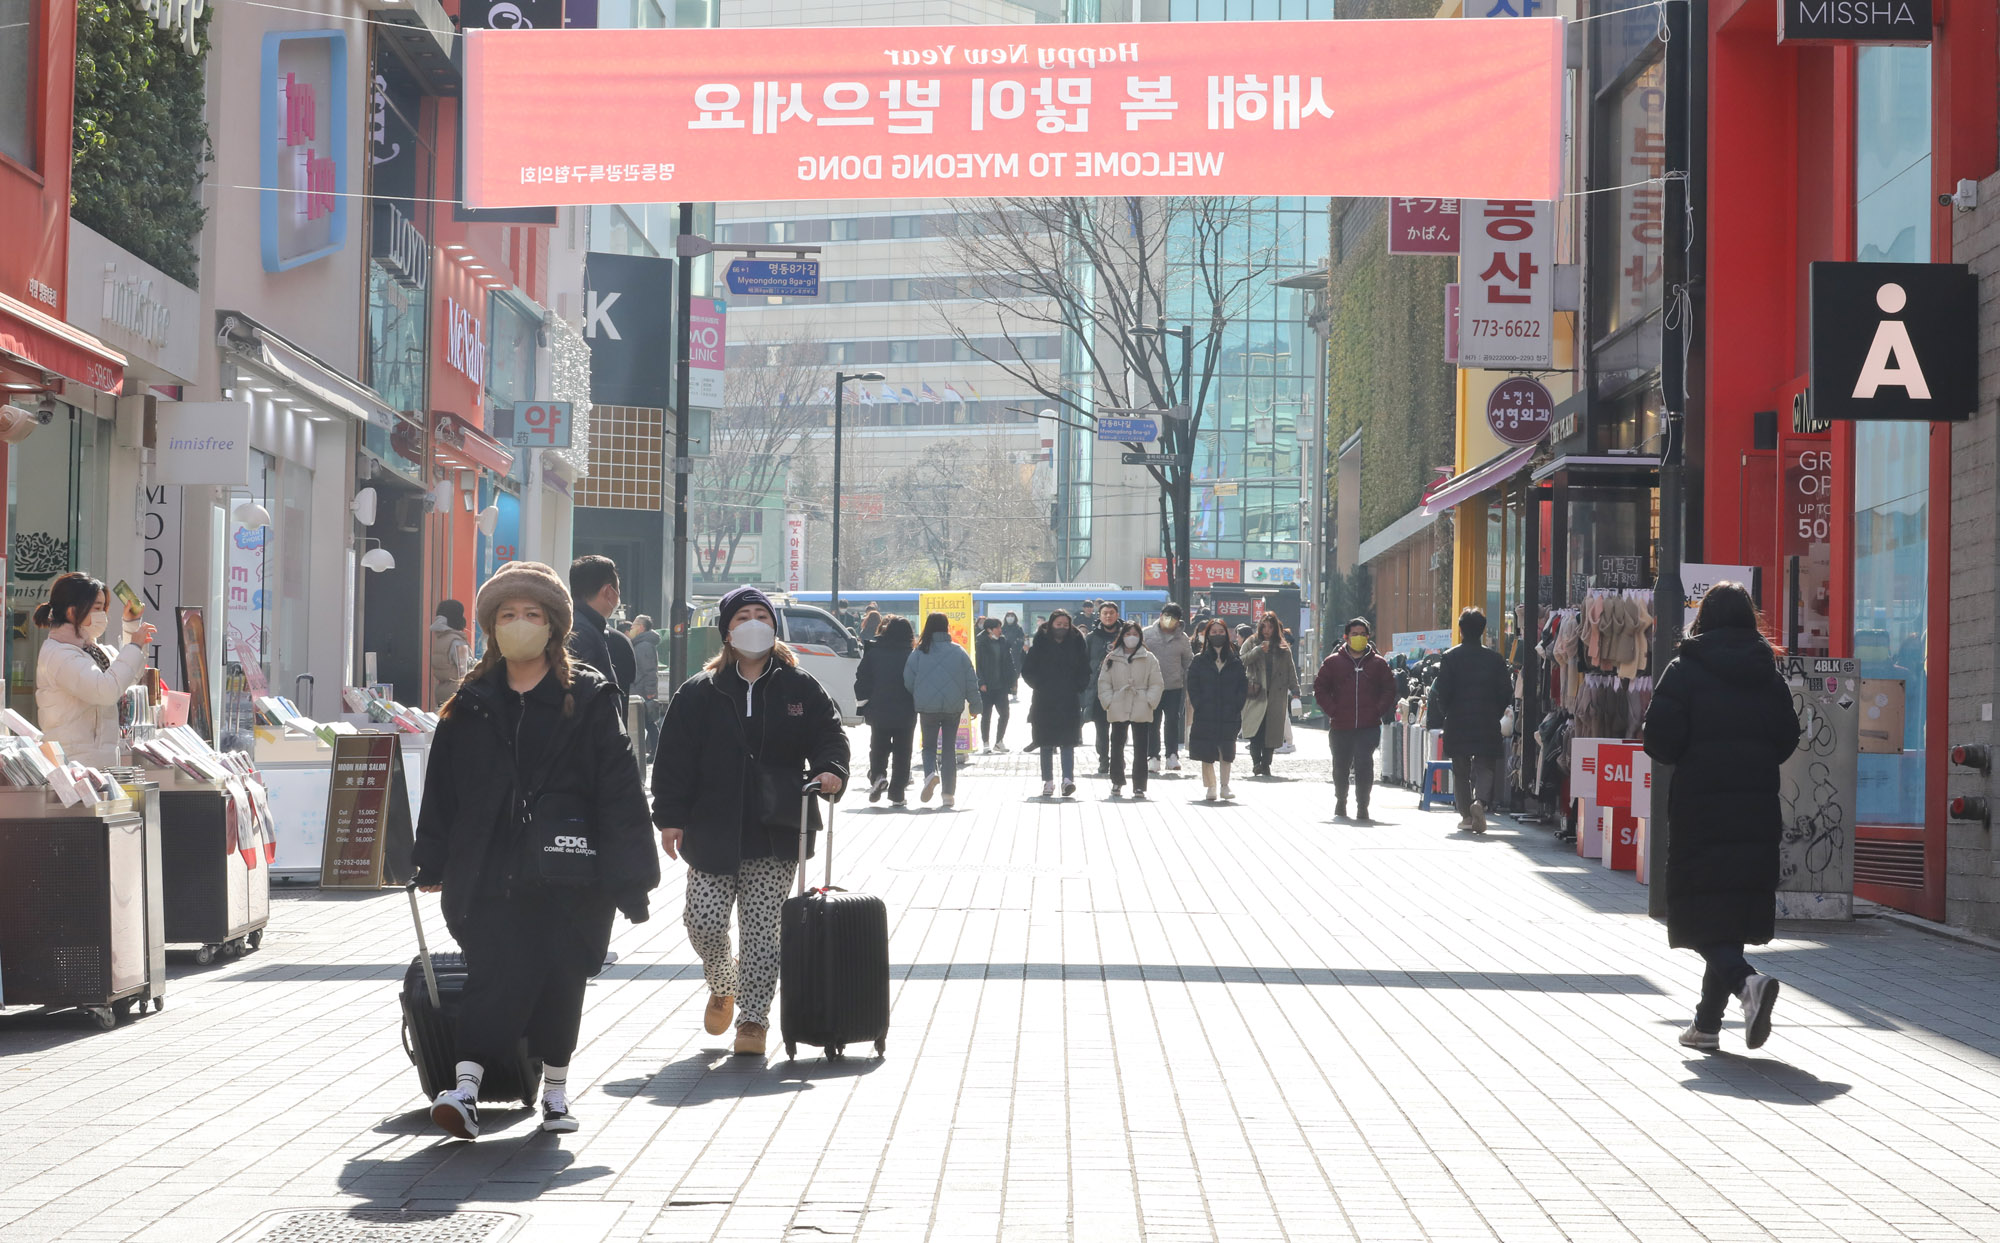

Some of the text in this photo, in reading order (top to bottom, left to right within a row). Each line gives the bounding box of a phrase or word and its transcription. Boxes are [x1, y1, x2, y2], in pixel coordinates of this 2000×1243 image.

[1800, 1, 1915, 24] MISSHA
[1407, 226, 1450, 241] かばん
[390, 203, 427, 289] LLOYD
[768, 263, 816, 276] 명동8가길
[737, 276, 816, 286] Myeongdong 8ga-gil
[102, 262, 170, 348] innisfree
[1472, 320, 1540, 337] 773-6622
[447, 296, 485, 406] McNally
[1502, 391, 1534, 406] 노정식
[525, 405, 562, 444] 약
[1491, 408, 1550, 429] 성형외과
[169, 436, 234, 450] innisfree
[1798, 518, 1831, 539] 50
[1205, 567, 1234, 579] 한의원
[925, 596, 966, 609] Hikari
[1218, 601, 1249, 615] 상품권
[1815, 660, 1840, 672] 4BLK
[338, 763, 387, 772] MOON HAIR SALON
[554, 835, 588, 849] CDG
